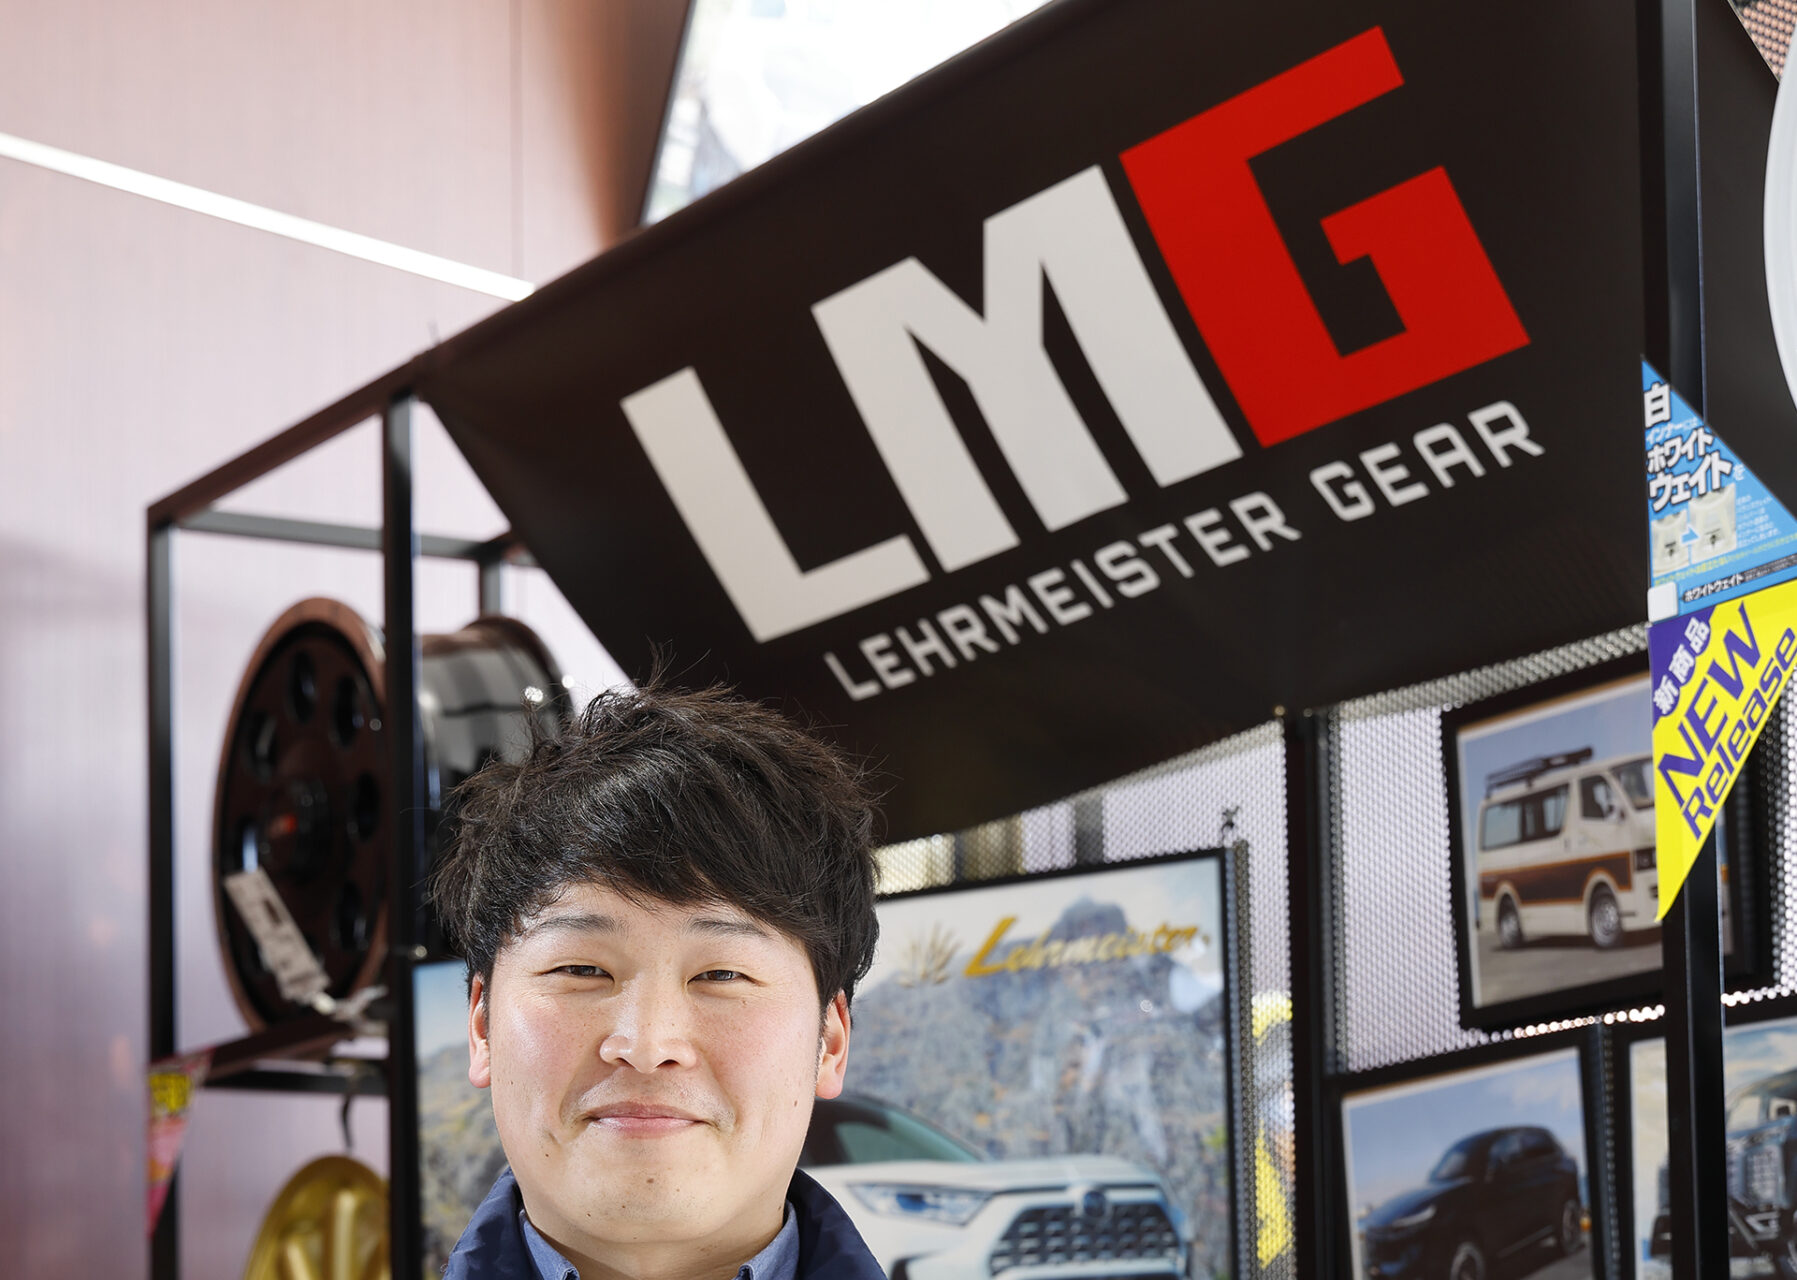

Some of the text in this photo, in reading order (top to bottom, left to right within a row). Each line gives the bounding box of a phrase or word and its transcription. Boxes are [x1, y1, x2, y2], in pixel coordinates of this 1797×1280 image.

[620, 25, 1531, 644] LMG
[1644, 382, 1671, 428] 白
[1647, 427, 1715, 474] ホワイト
[824, 401, 1545, 702] LEHRMEISTER GEAR
[1684, 573, 1744, 602] ホワイトウェイト
[1653, 616, 1711, 715] 新商品
[1658, 600, 1761, 810] NEW
[1683, 627, 1797, 840] Release
